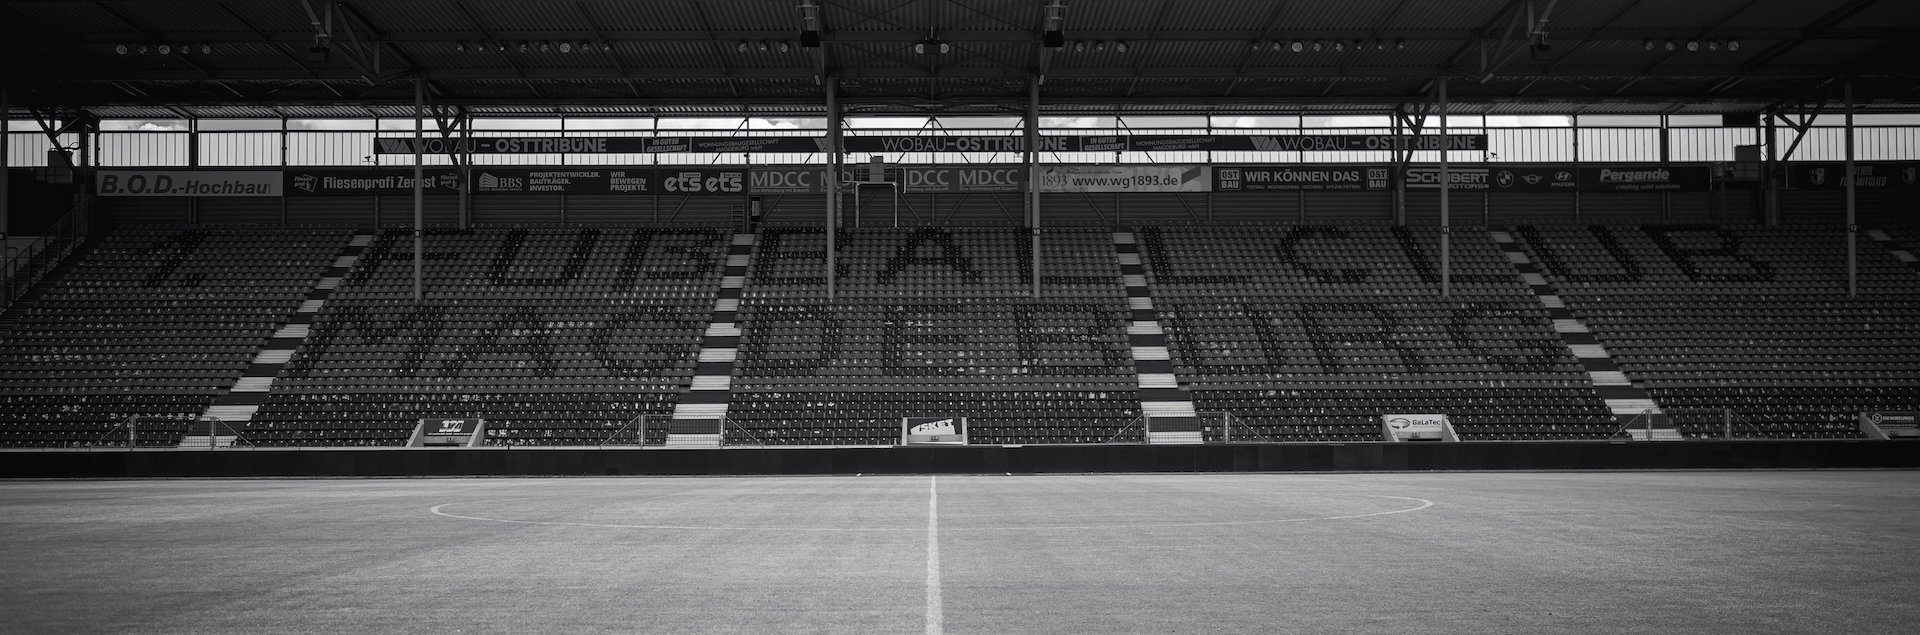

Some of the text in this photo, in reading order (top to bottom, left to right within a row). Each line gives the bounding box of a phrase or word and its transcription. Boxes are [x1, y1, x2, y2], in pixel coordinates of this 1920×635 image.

[411, 139, 477, 153] WOAU
[495, 138, 607, 152] OSTTRIBÜNE
[881, 137, 1068, 151] WOBAU-OSTTRINE
[1282, 136, 1346, 150] WOBAU
[750, 171, 810, 186] MDCC
[959, 170, 1018, 185] MDCC
[1221, 169, 1239, 179] OST
[1245, 171, 1270, 182] WIR
[1274, 169, 1330, 182] KÖNNEN
[1368, 168, 1388, 178] OST
[1406, 169, 1489, 183] SCHBERT
[1600, 168, 1670, 182] Pergande
[101, 174, 268, 194] B.O.D.-Hochbau
[323, 176, 437, 190] Fliesenprofi Zerst
[500, 178, 522, 188] BBS
[530, 184, 565, 192] INVESTOR.
[610, 184, 648, 192] PROJEKTE.
[664, 172, 743, 192] ets ets
[1042, 175, 1068, 187] 1893
[1072, 175, 1178, 188] www.wg1893.de
[1221, 180, 1239, 189] BAU
[1368, 180, 1388, 188] BAU
[287, 305, 1562, 377] MAGDEBURG
